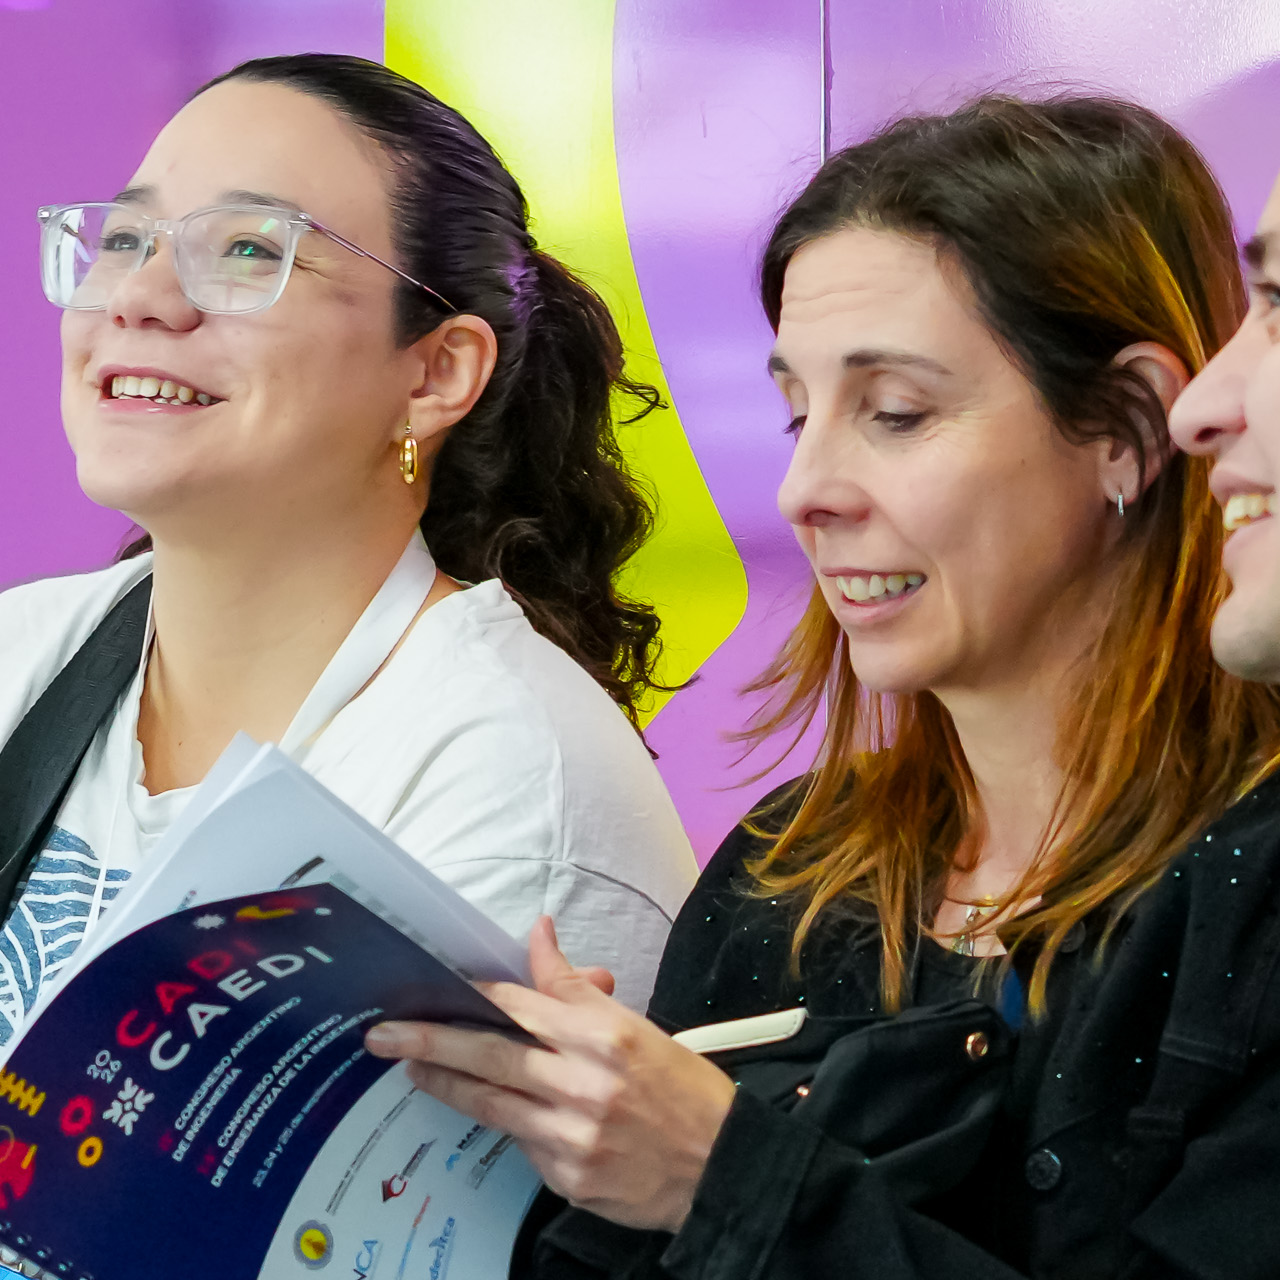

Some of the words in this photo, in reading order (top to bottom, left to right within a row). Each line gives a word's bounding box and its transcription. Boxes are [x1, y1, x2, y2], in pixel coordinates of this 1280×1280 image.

[116, 940, 257, 1047] CADI
[149, 945, 333, 1071] CAEDI
[86, 1050, 111, 1079] 20
[101, 1060, 122, 1084] 26
[175, 1056, 232, 1130] CONGRESO
[230, 995, 302, 1058] ARGENTINO
[172, 1140, 191, 1162] DE
[210, 1165, 228, 1187] DE
[279, 1067, 298, 1088] DE
[293, 1053, 312, 1070] LA
[217, 1073, 274, 1148] CONGRESO
